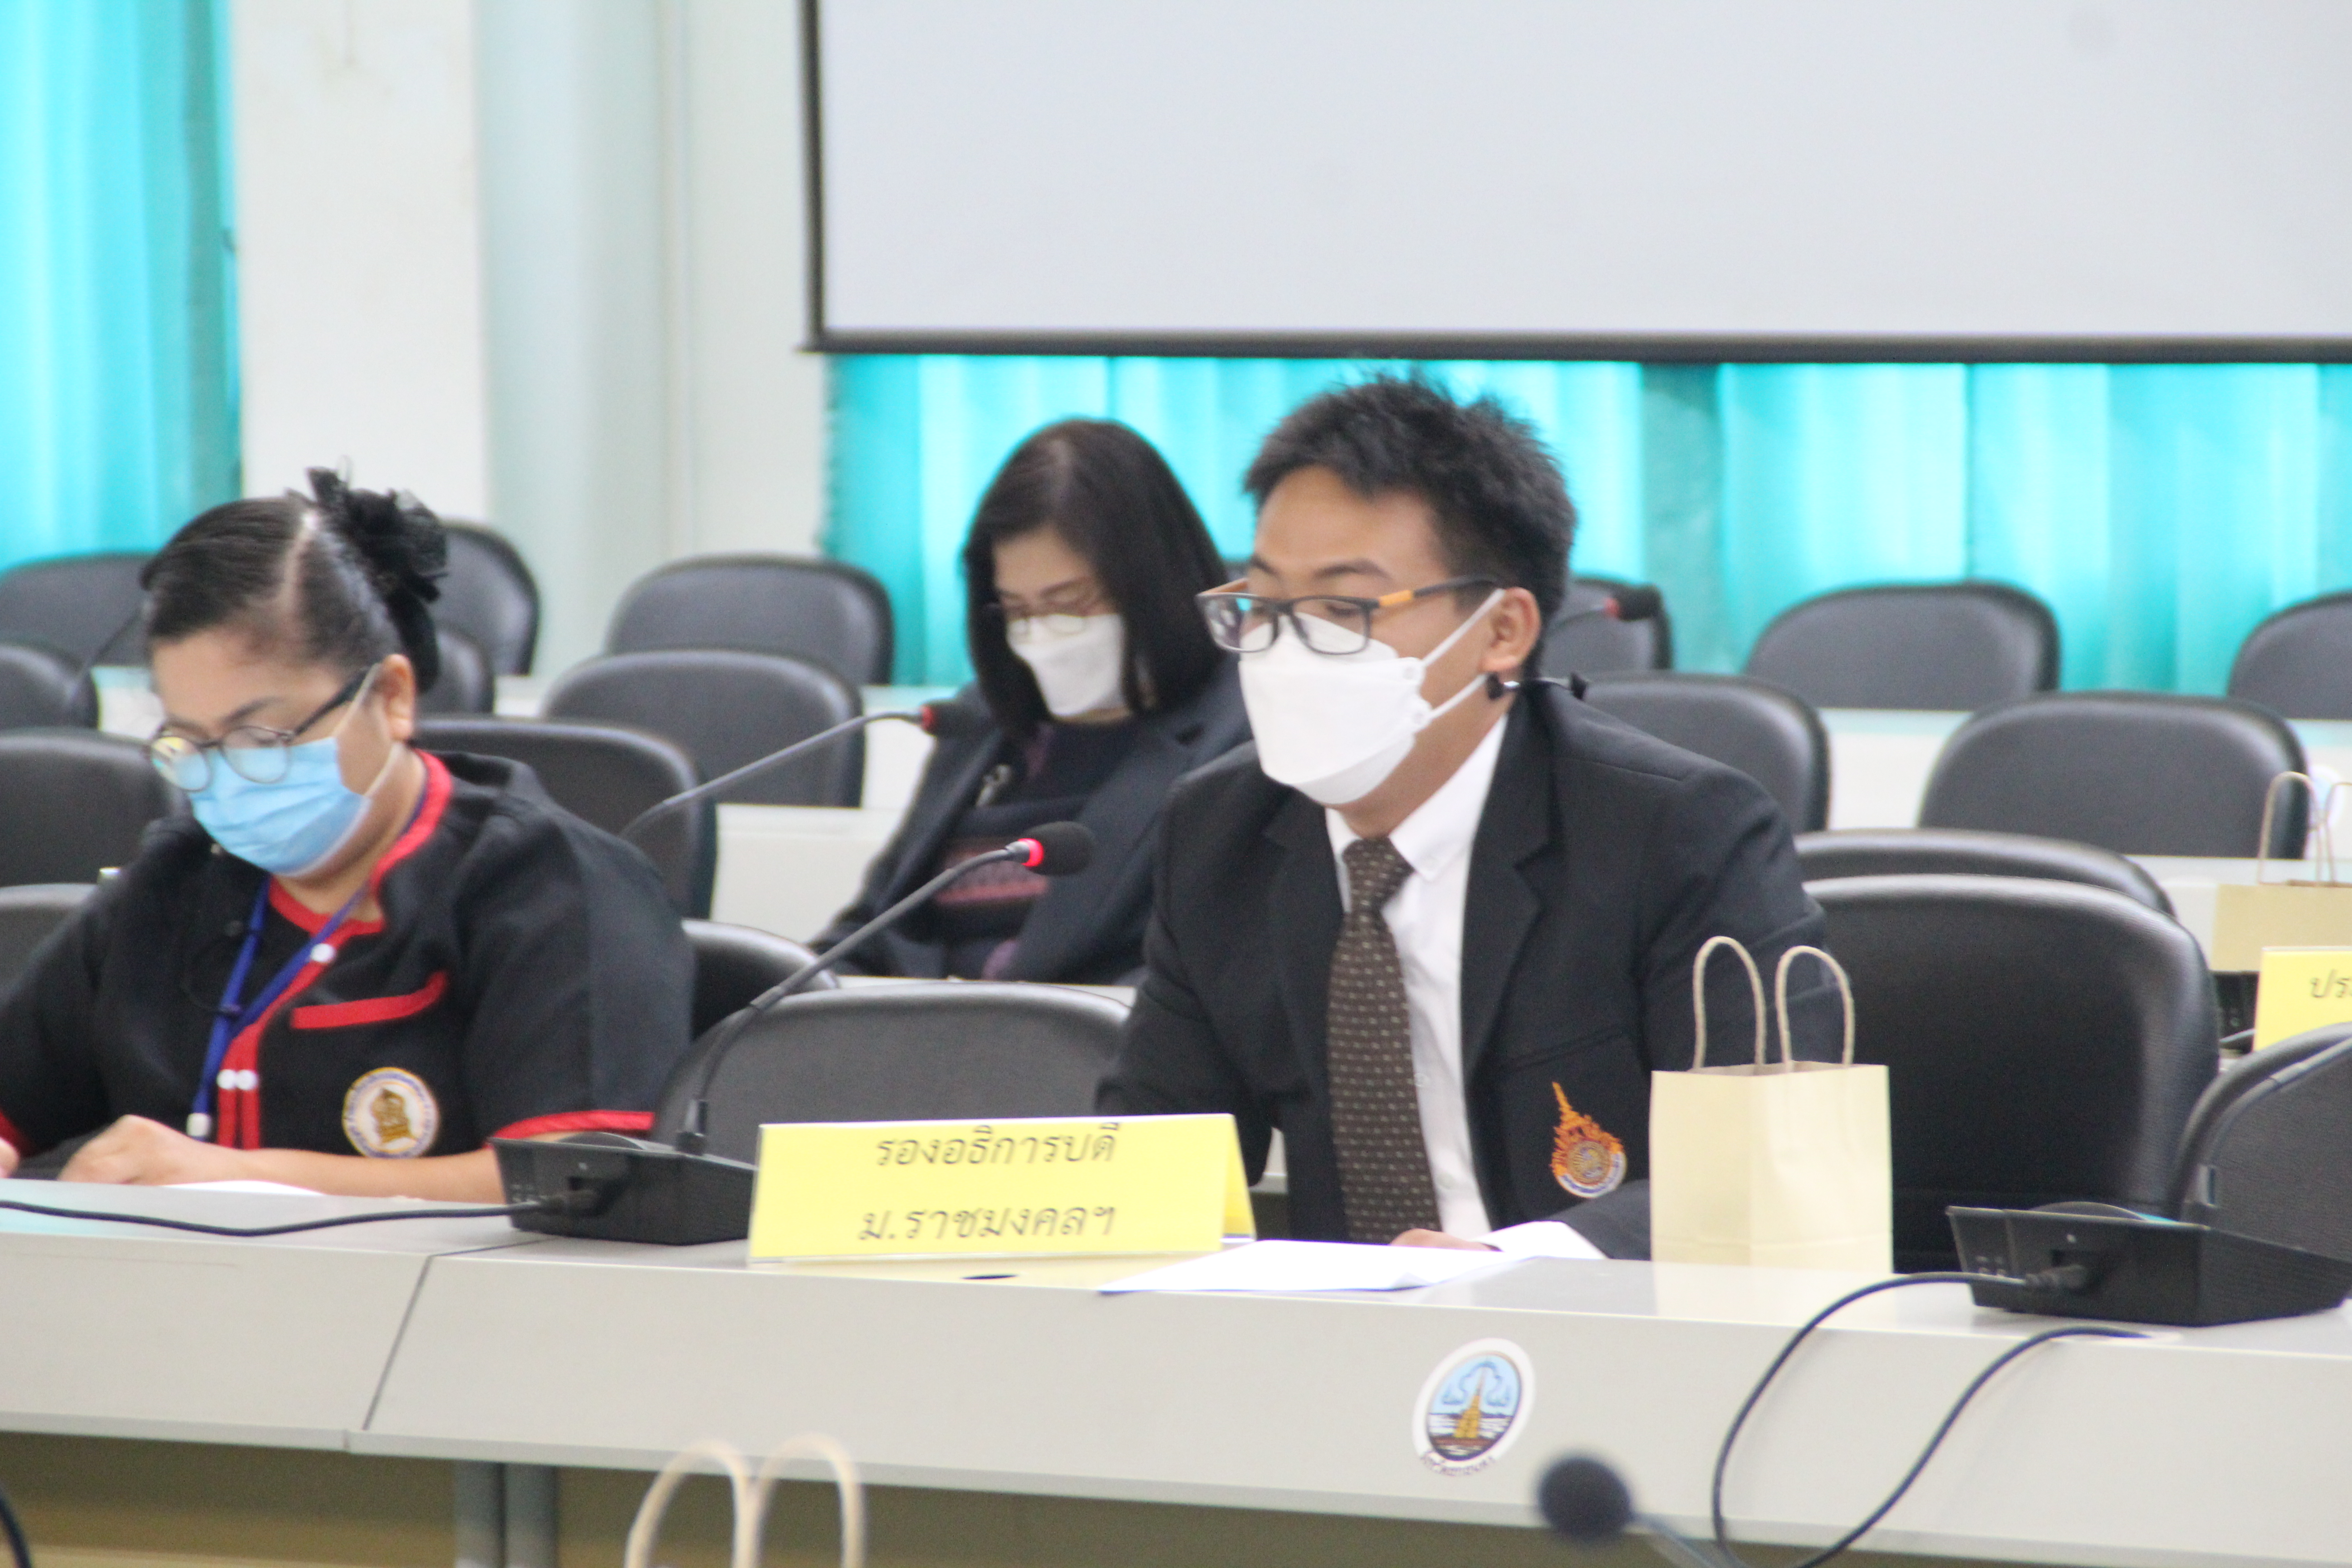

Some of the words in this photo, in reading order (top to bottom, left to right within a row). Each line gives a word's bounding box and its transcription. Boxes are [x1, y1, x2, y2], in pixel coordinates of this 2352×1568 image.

[2310, 969, 2352, 998] ปร
[877, 1122, 1120, 1166] รองอธิการบดี
[857, 1205, 1117, 1240] ม.ราชมงคลฯ
